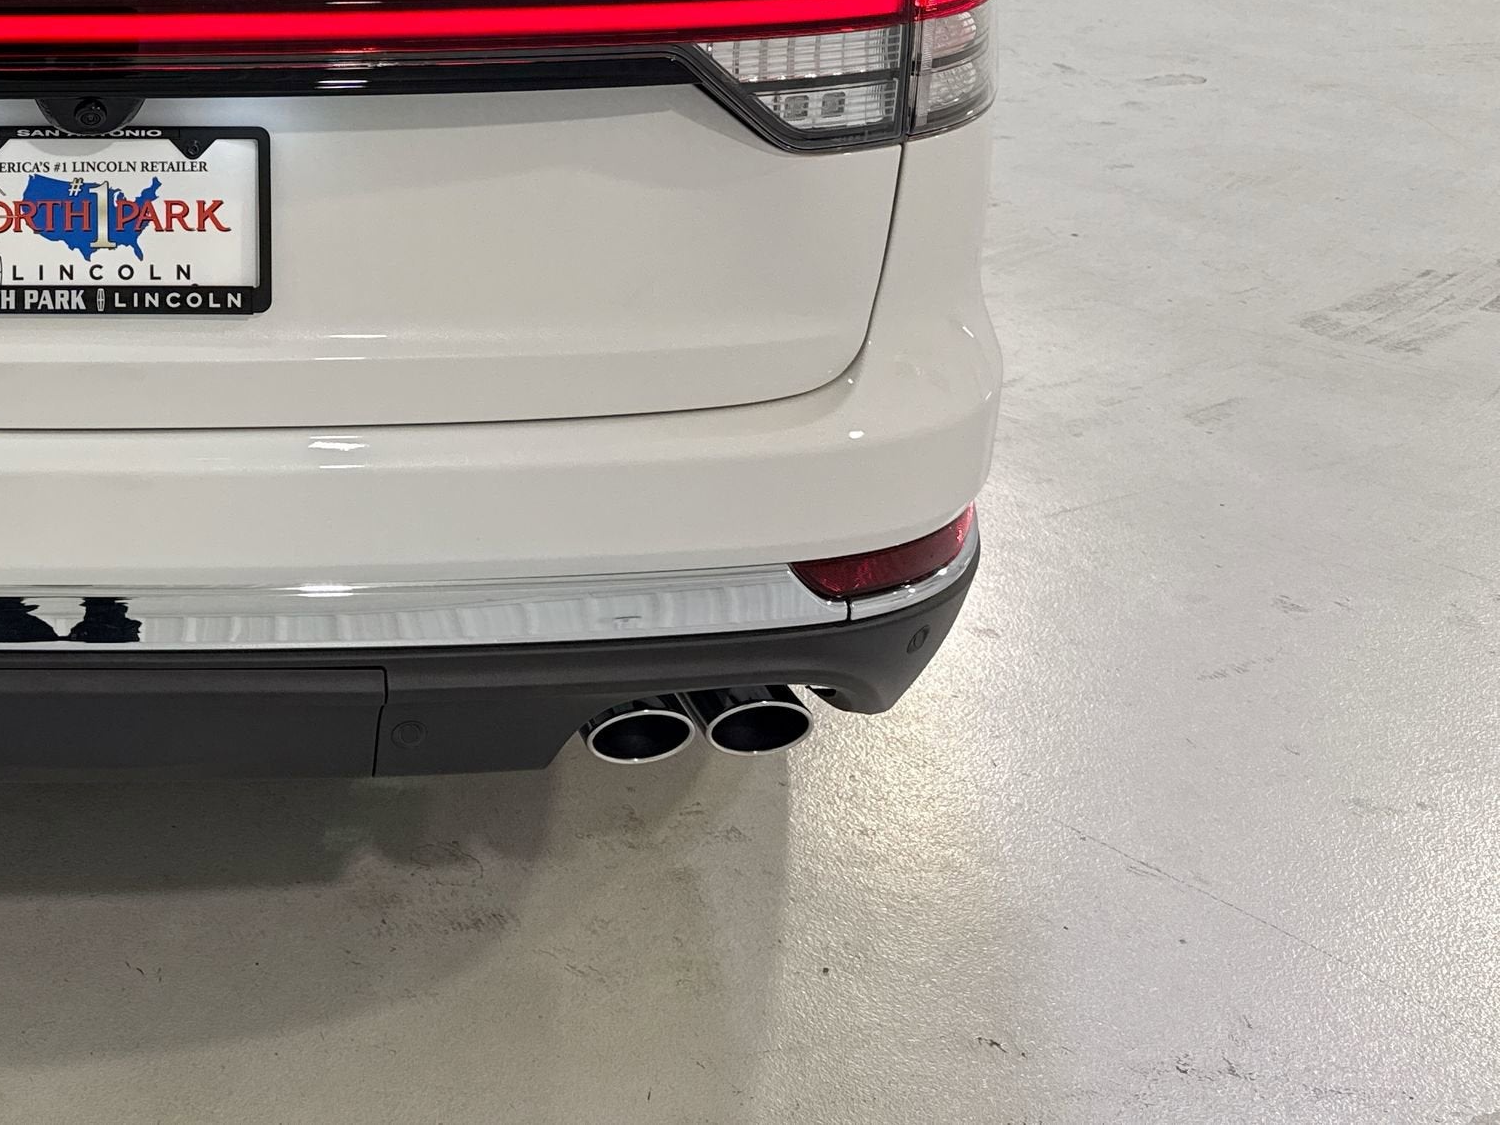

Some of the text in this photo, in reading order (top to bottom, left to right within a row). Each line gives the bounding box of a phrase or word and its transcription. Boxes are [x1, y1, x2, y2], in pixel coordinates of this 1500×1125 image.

[16, 129, 60, 137] SAN
[54, 161, 67, 173] #1
[72, 161, 137, 173] LINCOLN
[141, 160, 208, 173] RETAILER
[116, 198, 232, 233] PARK
[12, 264, 191, 281] LINCOLN
[24, 289, 87, 310] PARK
[114, 292, 242, 308] LINCOLN
